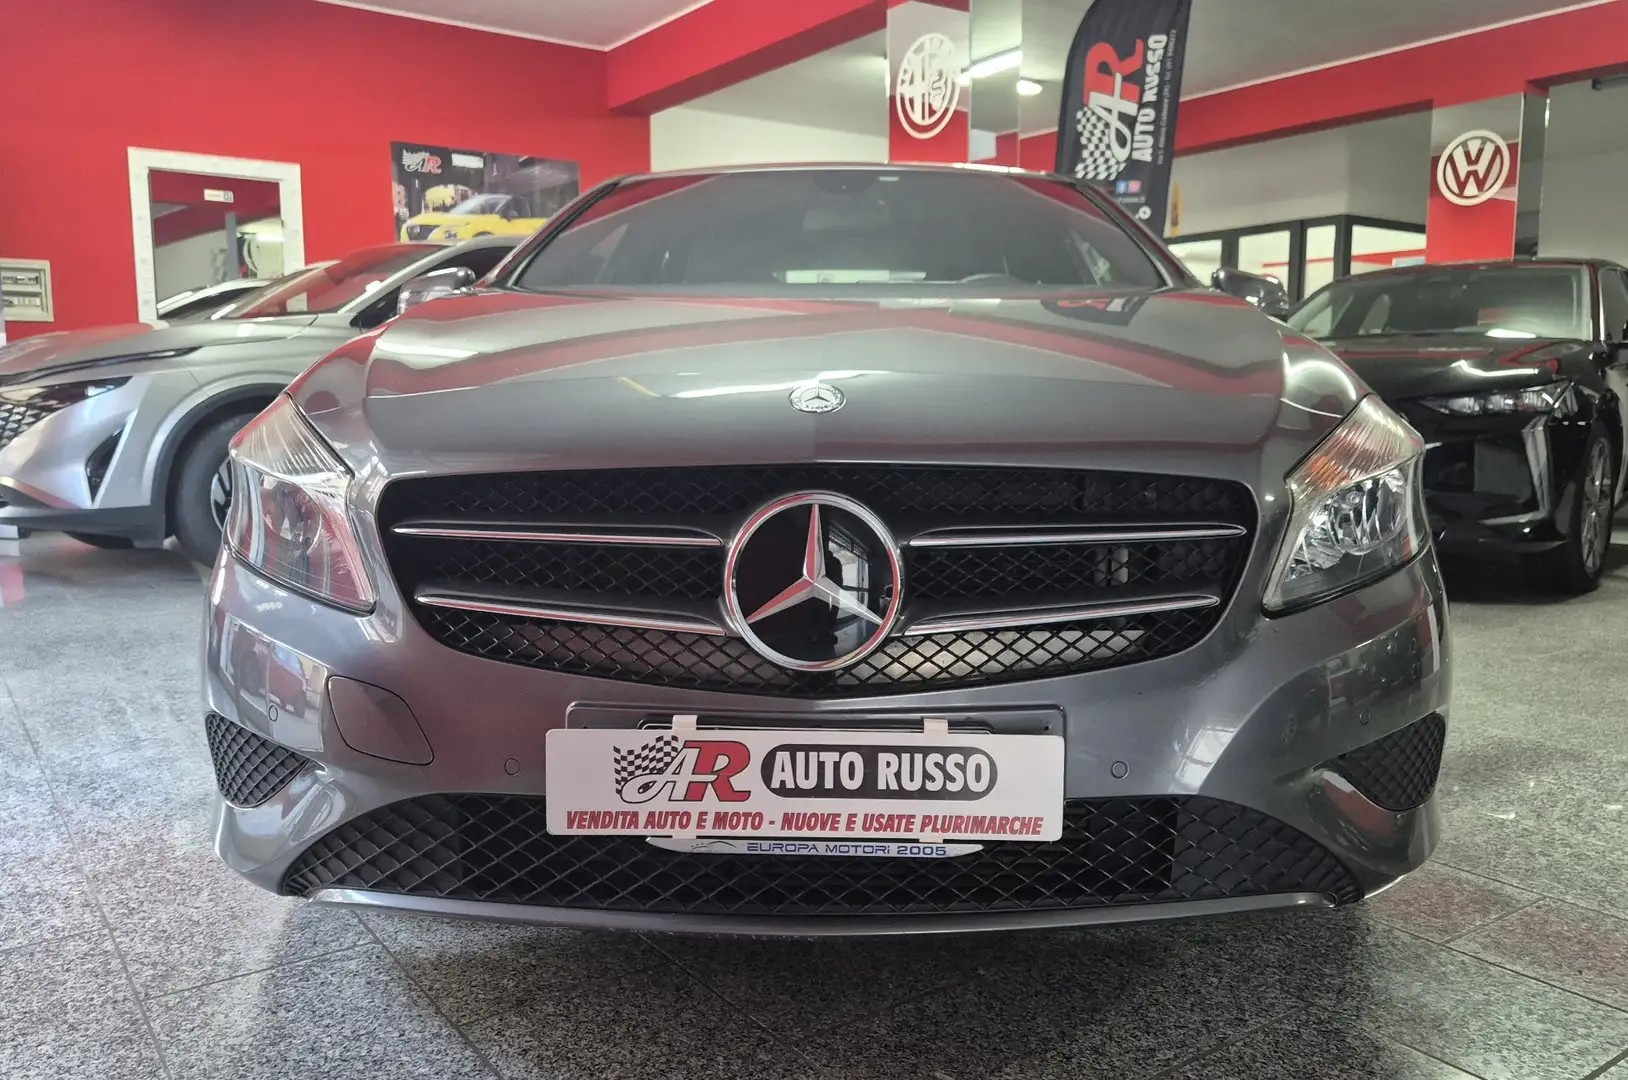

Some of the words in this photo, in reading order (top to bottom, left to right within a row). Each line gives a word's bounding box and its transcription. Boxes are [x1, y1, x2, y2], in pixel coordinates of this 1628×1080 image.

[1141, 34, 1168, 103] RUSSO
[1083, 39, 1144, 163] AR
[1131, 107, 1156, 162] AUTO
[620, 740, 752, 804] AR
[770, 751, 864, 790] AUTO
[877, 752, 991, 792] RUSSO
[566, 810, 639, 830] VENDITA
[643, 810, 692, 830] AUTO
[696, 811, 708, 830] E
[712, 811, 763, 831] MOTO
[780, 811, 841, 832] NUOVE
[845, 813, 858, 832] E
[862, 813, 916, 833] USATE
[919, 814, 1044, 836] PLURIMARCHE
[746, 842, 819, 853] EUROPA
[897, 845, 947, 856] 2005
